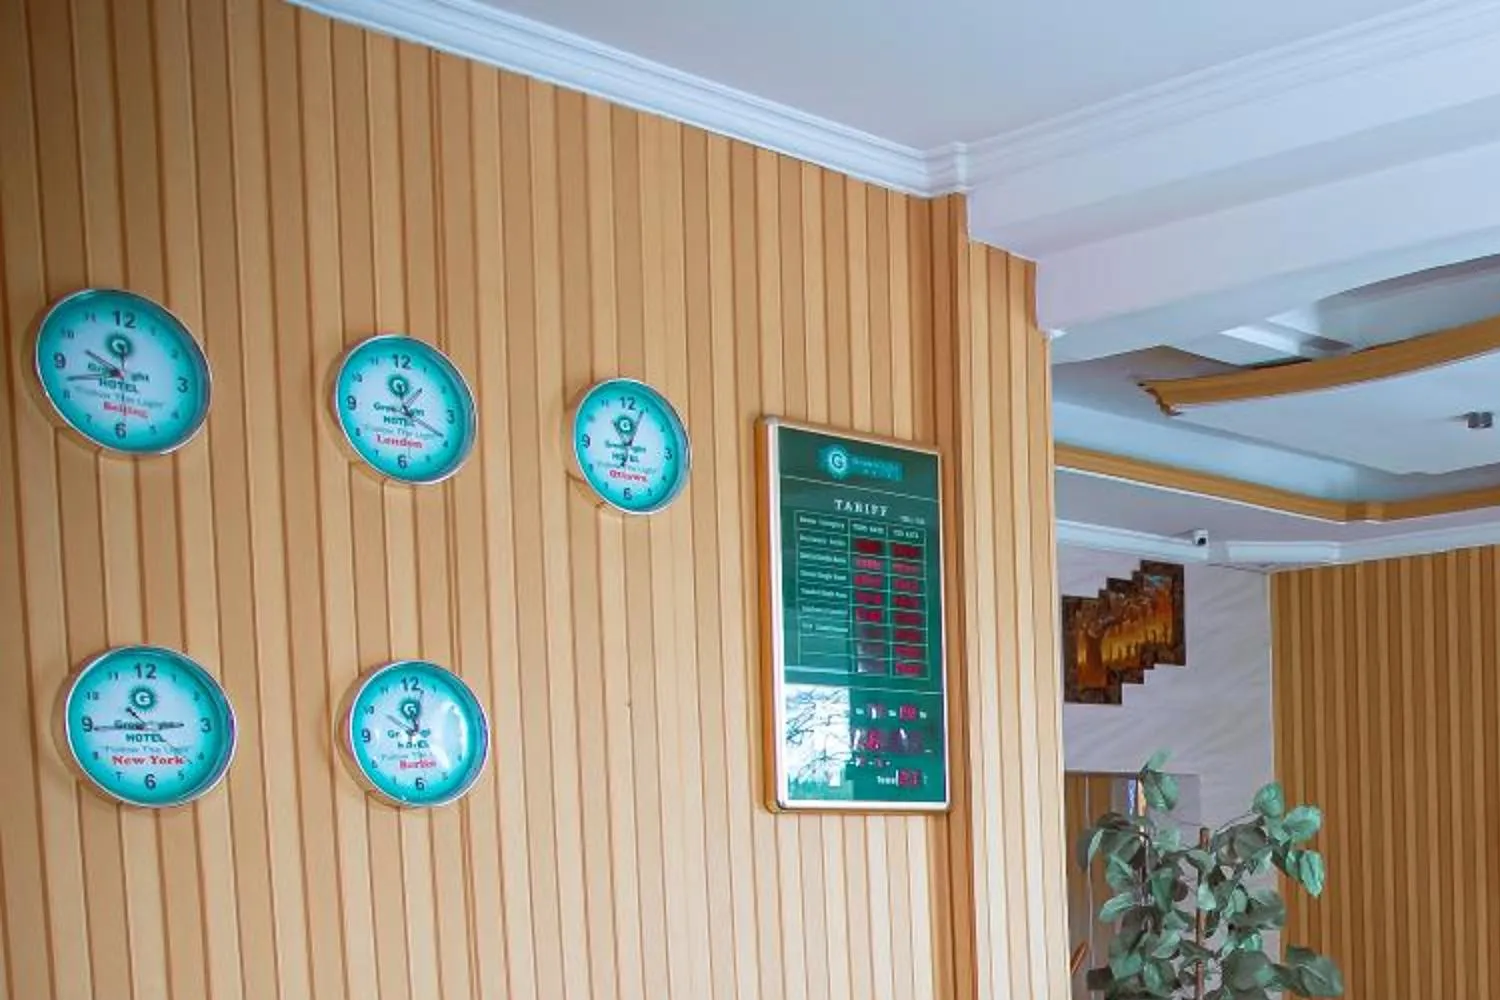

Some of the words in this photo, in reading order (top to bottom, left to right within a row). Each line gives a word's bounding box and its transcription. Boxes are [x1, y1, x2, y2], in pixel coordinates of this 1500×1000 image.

[113, 310, 136, 329] 12
[54, 352, 65, 368] 9
[392, 354, 411, 369] 12
[177, 376, 188, 393] 3
[347, 395, 357, 410] 9
[620, 397, 636, 410] 12
[447, 409, 455, 424] 3
[115, 423, 127, 438] 6
[377, 434, 423, 449] London
[582, 434, 591, 448] 9
[397, 455, 408, 468] 6
[664, 448, 672, 460] 3
[623, 487, 632, 500] 6
[834, 499, 890, 517] TARIFF
[134, 663, 157, 679] 12
[401, 676, 419, 691] 12
[81, 716, 93, 732] 9
[200, 718, 212, 733] 3
[126, 733, 166, 742] HOTEL
[361, 728, 371, 743] 9
[112, 755, 145, 765] New
[150, 755, 184, 765] York
[144, 773, 157, 790] 6
[178, 770, 185, 780] 5
[415, 778, 425, 790] 6
